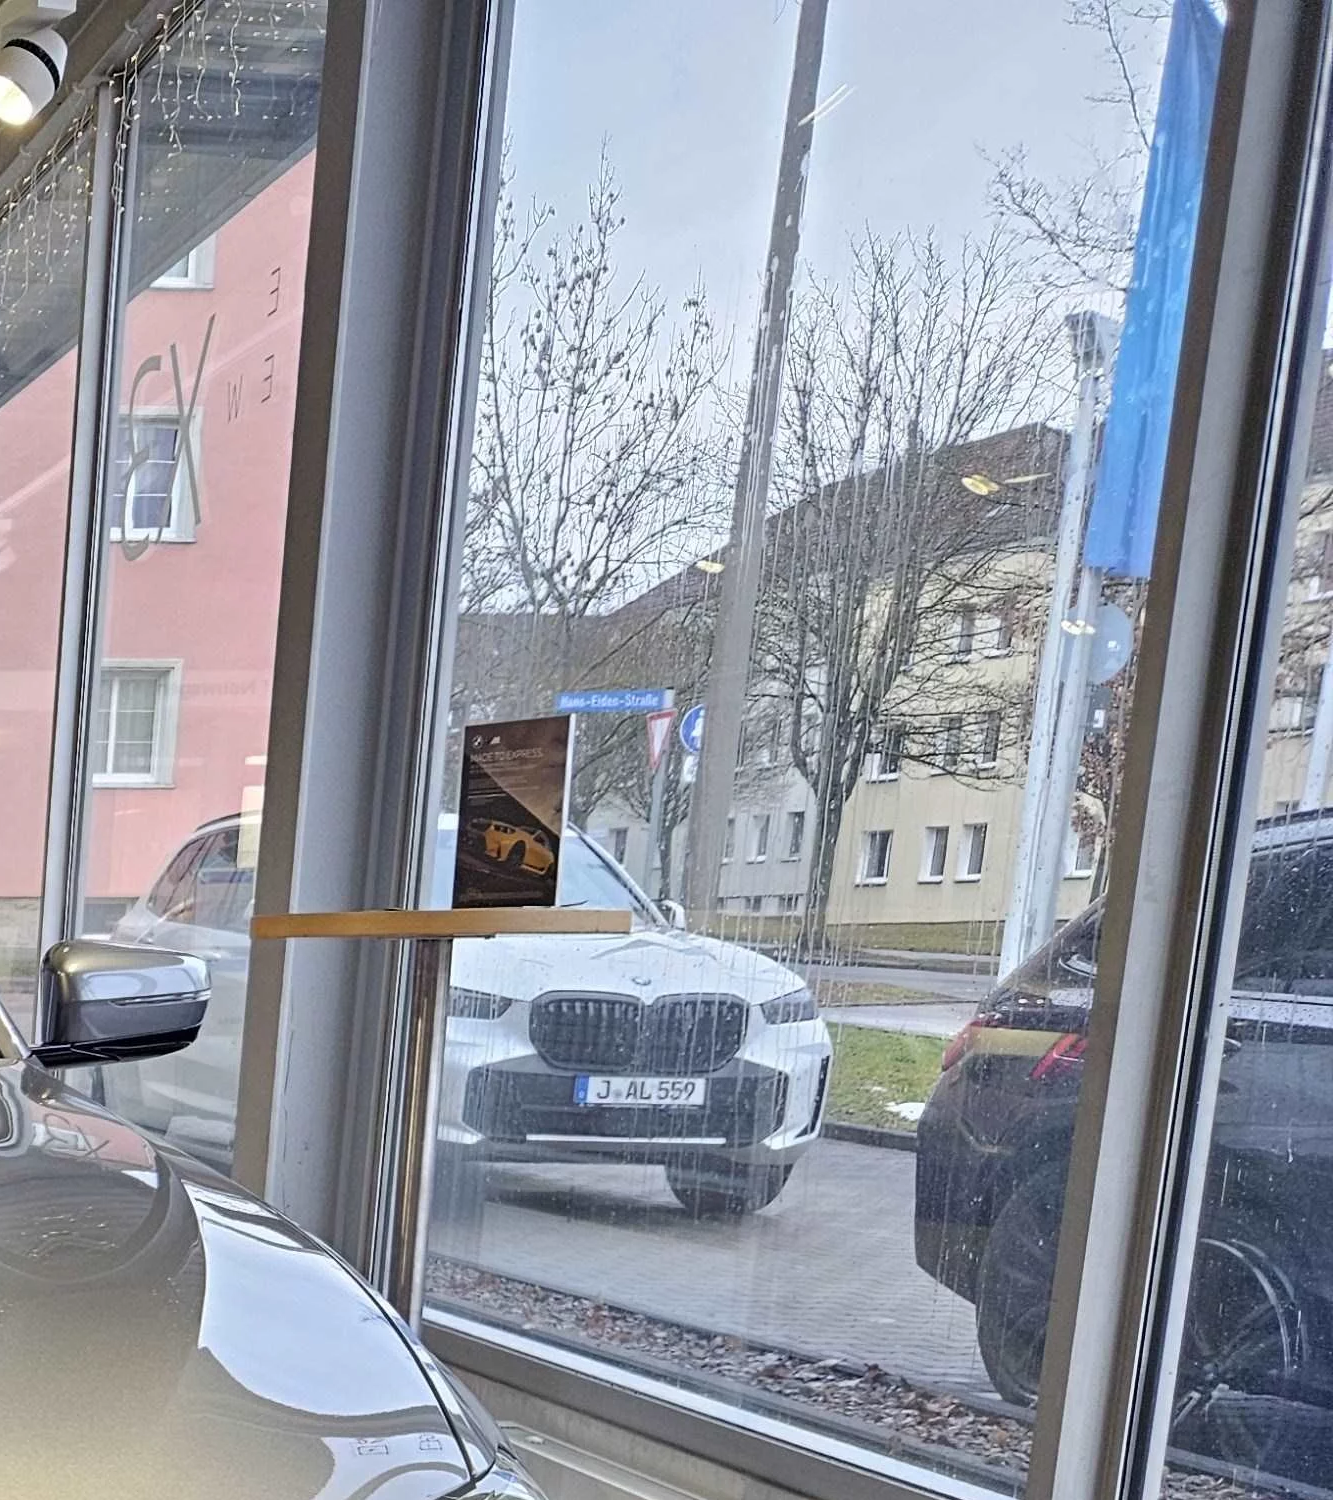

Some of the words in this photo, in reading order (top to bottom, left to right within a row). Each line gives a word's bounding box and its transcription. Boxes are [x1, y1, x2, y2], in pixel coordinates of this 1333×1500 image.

[596, 1080, 611, 1100] J
[625, 1080, 652, 1100] AL
[656, 1081, 696, 1101] 559
